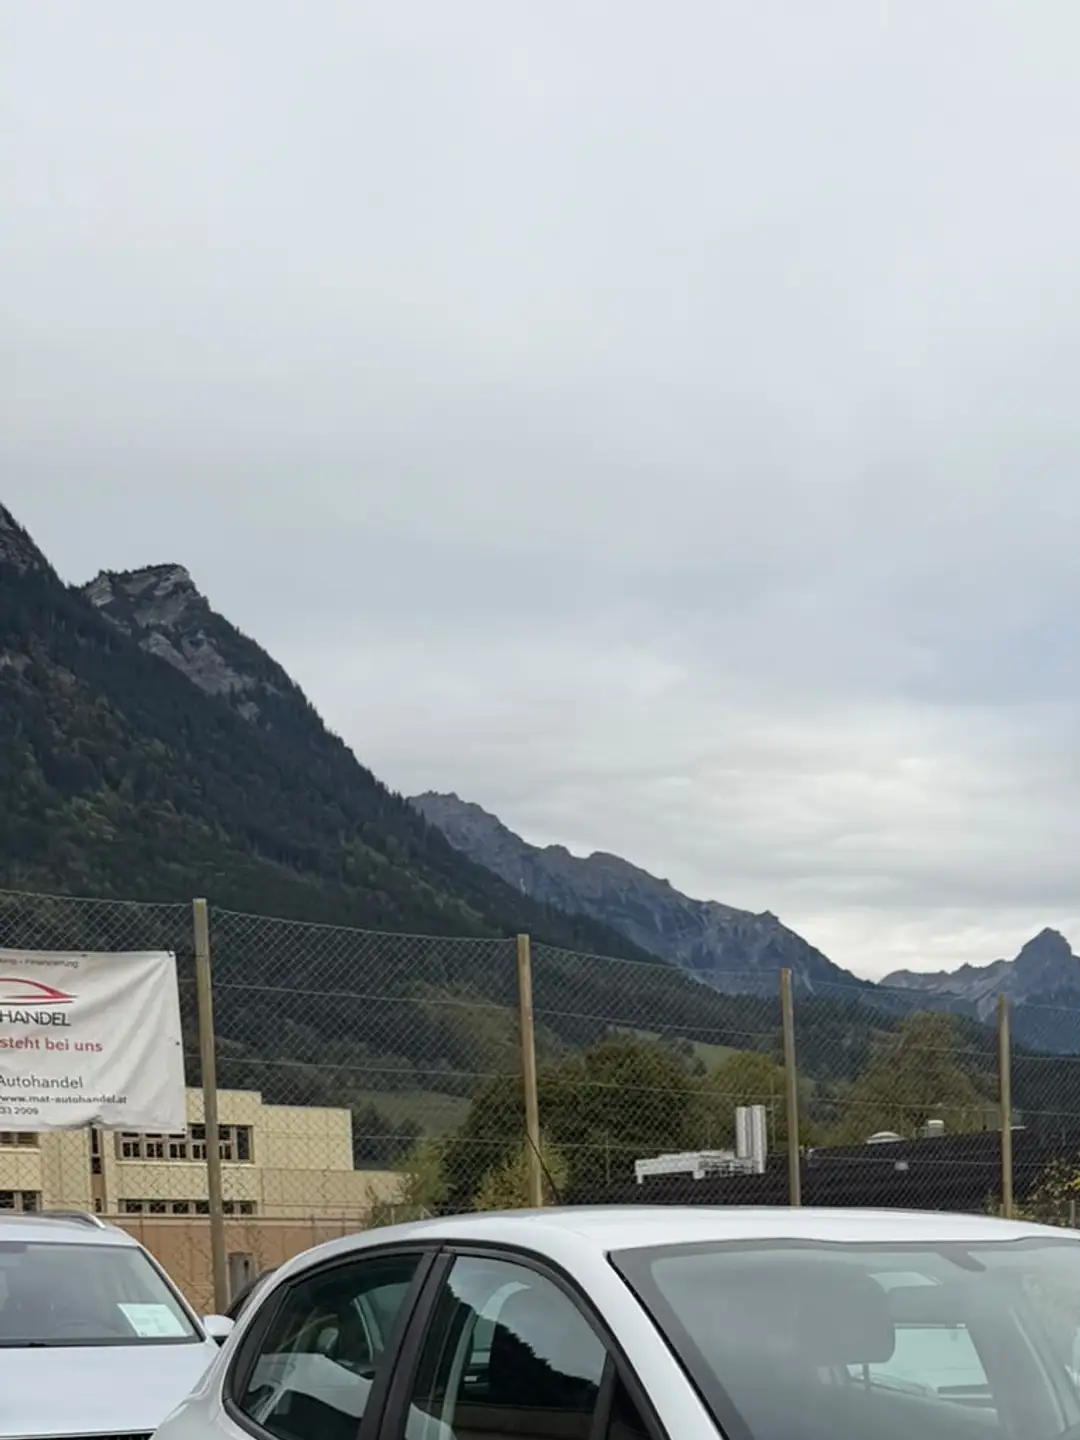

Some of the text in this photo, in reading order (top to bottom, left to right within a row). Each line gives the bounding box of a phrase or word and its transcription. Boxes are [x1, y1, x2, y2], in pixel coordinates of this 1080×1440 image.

[0, 1037, 103, 1052] steht bei uns
